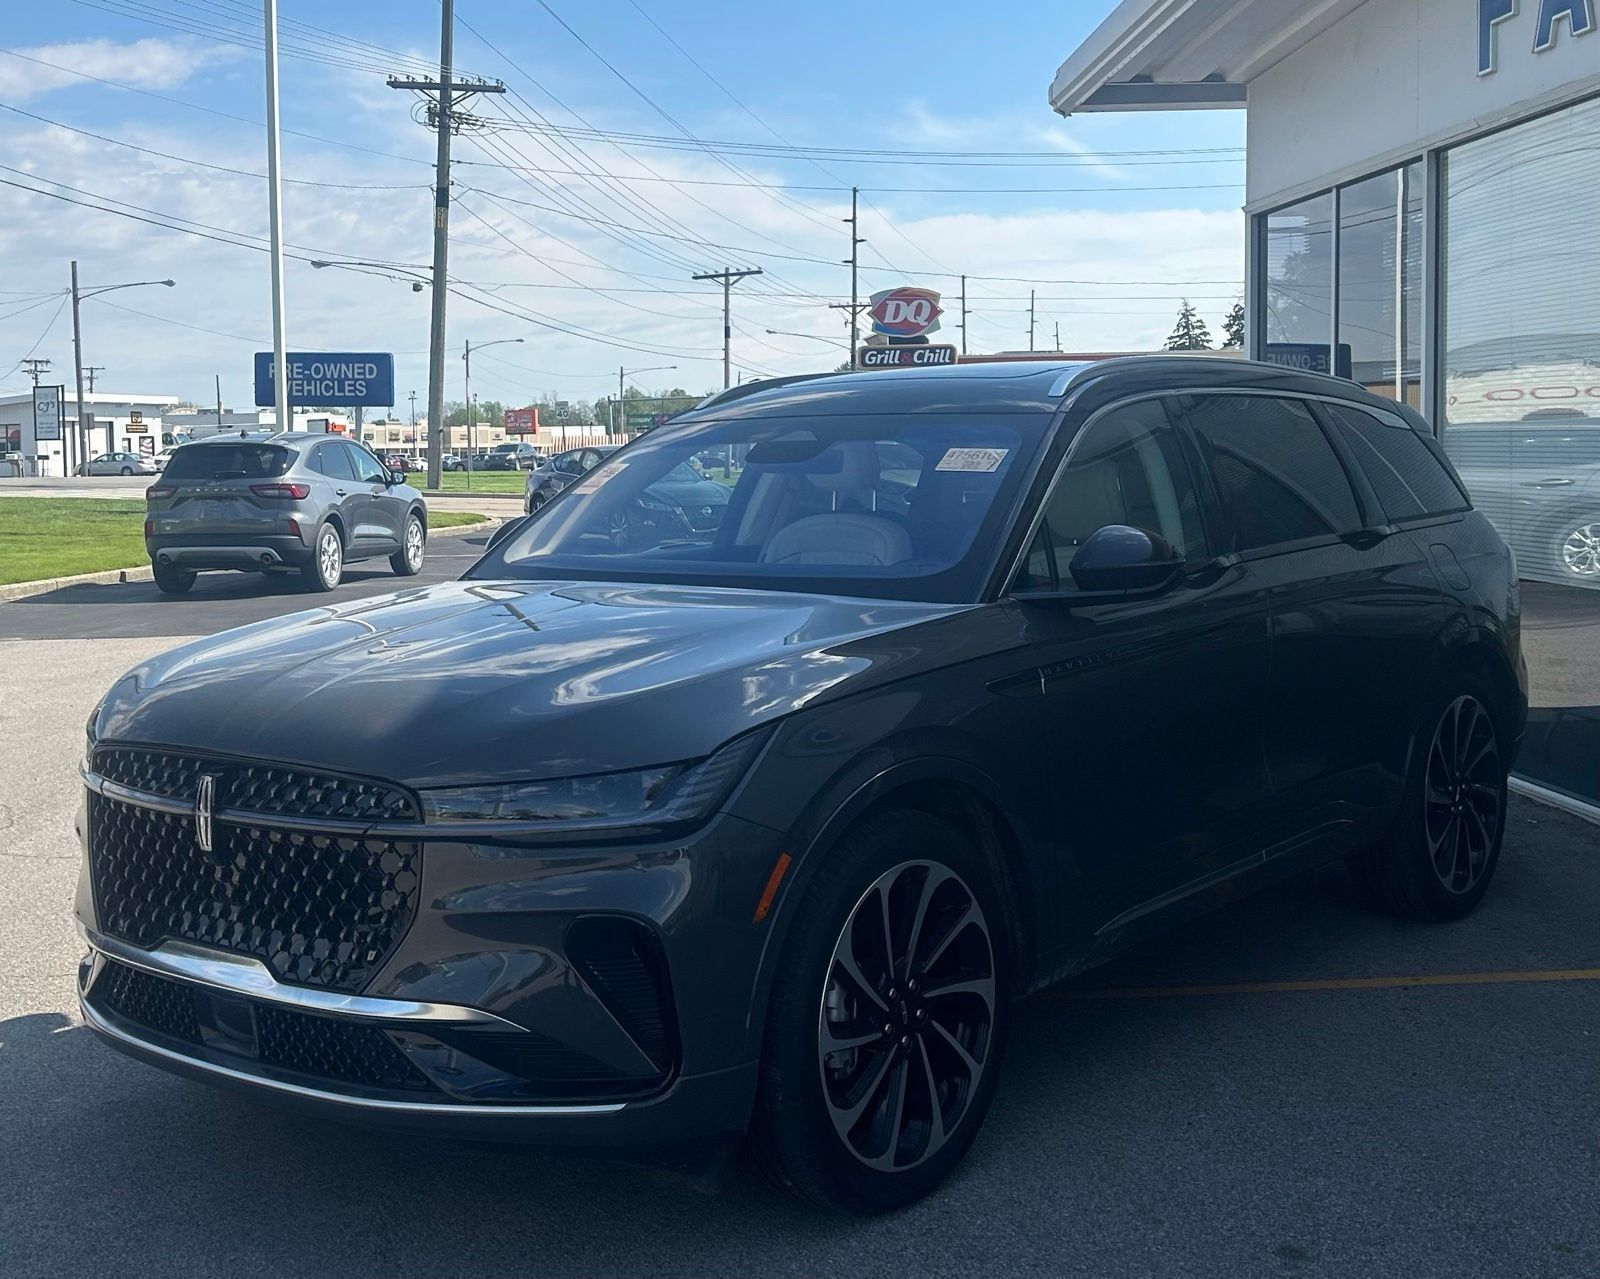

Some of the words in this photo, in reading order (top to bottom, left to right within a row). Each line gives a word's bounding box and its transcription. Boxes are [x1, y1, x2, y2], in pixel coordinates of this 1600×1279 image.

[882, 299, 932, 326] DQ
[864, 350, 900, 365] Grill
[901, 352, 912, 362] &
[913, 348, 951, 363] Chill
[556, 410, 569, 418] 40
